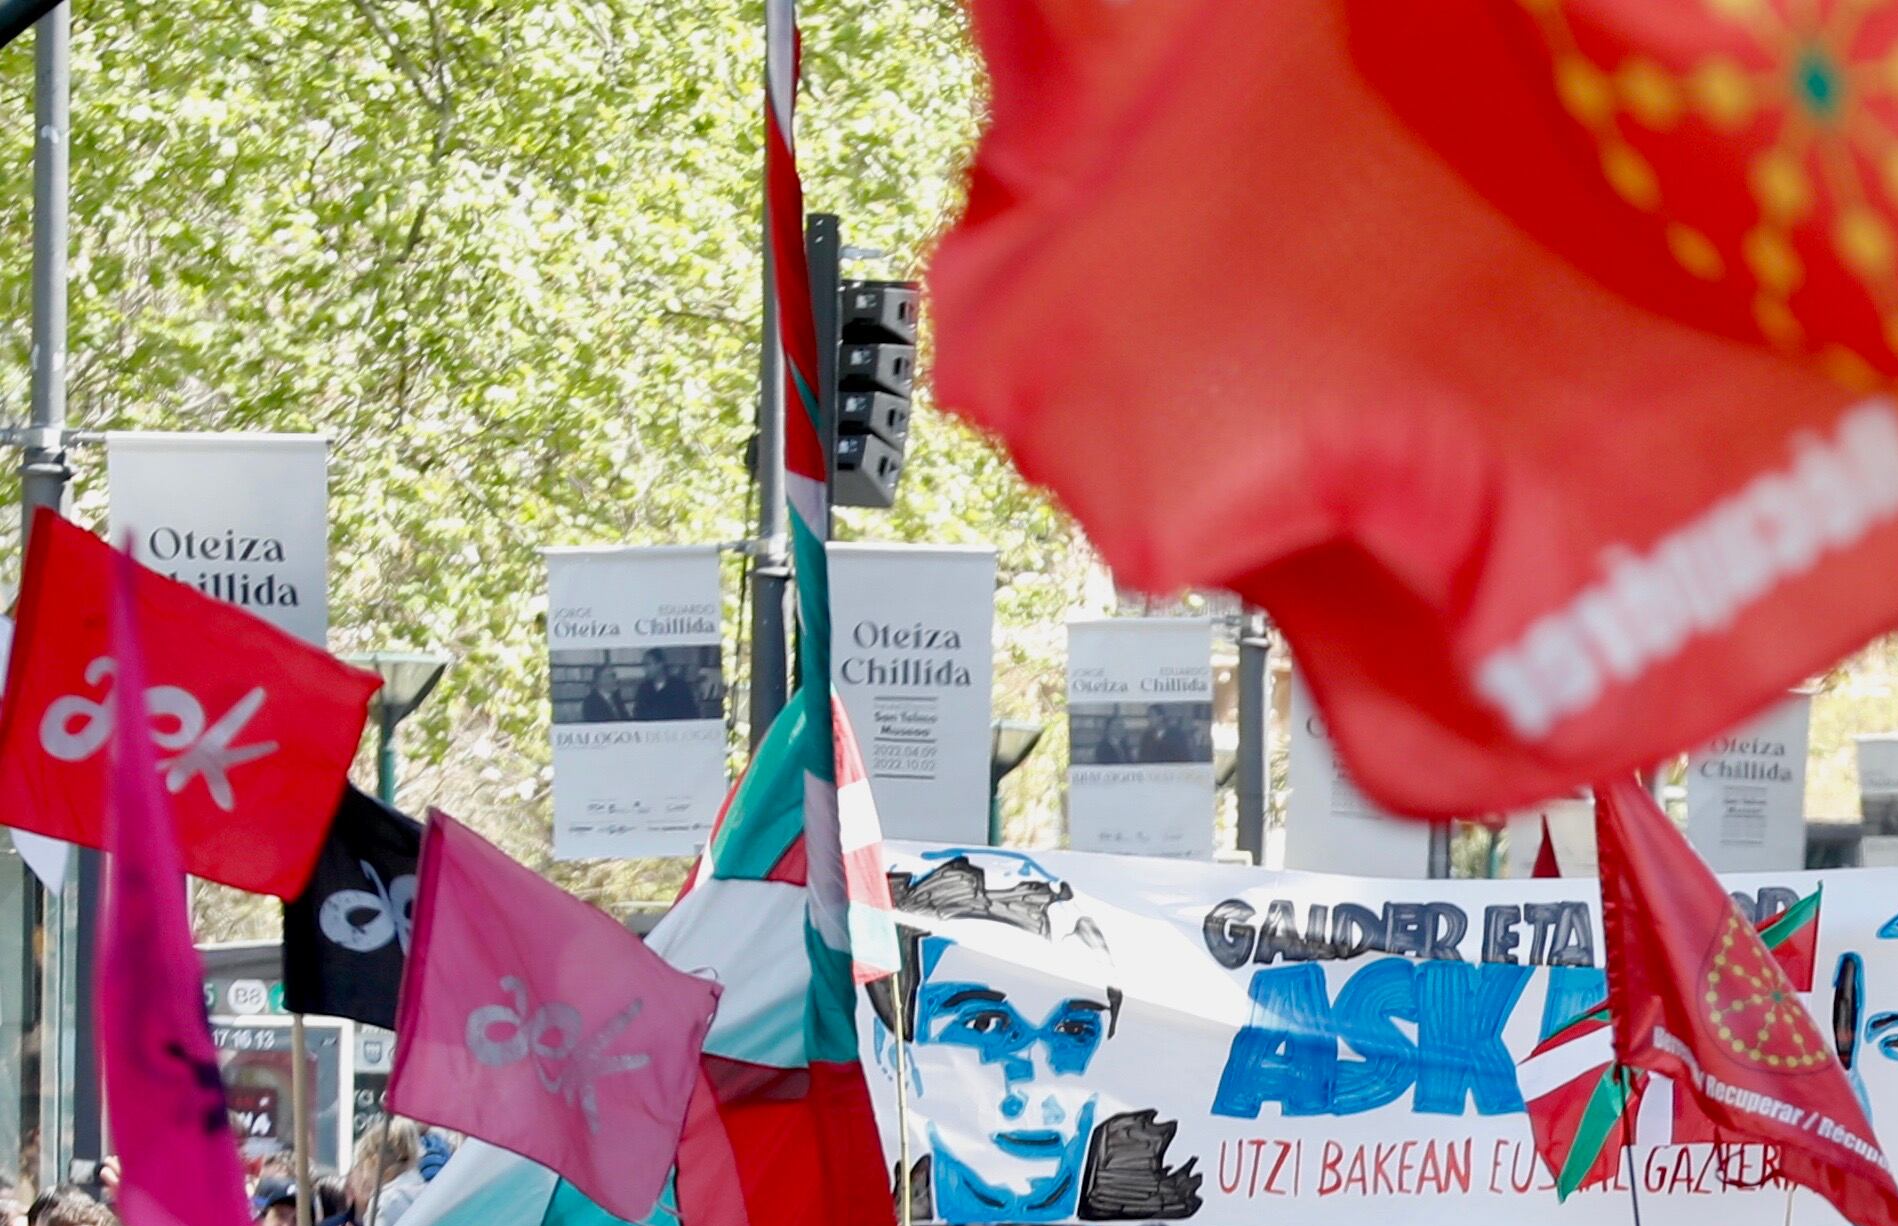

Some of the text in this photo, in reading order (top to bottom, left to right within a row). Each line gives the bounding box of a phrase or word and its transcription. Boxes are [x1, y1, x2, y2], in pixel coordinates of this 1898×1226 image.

[149, 527, 285, 562] Oteiza
[168, 571, 299, 607] illida
[553, 616, 715, 638] Oteiza Chillida
[853, 620, 961, 649] Oteiza
[841, 657, 971, 686] Chillida
[1140, 677, 1208, 692] Chillida
[1699, 760, 1793, 782] Chillida
[1482, 901, 1595, 967] ETA
[1706, 1074, 1803, 1126] Recuperar
[1219, 1139, 1302, 1196] UTZI
[1319, 1137, 1472, 1196] BAKEAN
